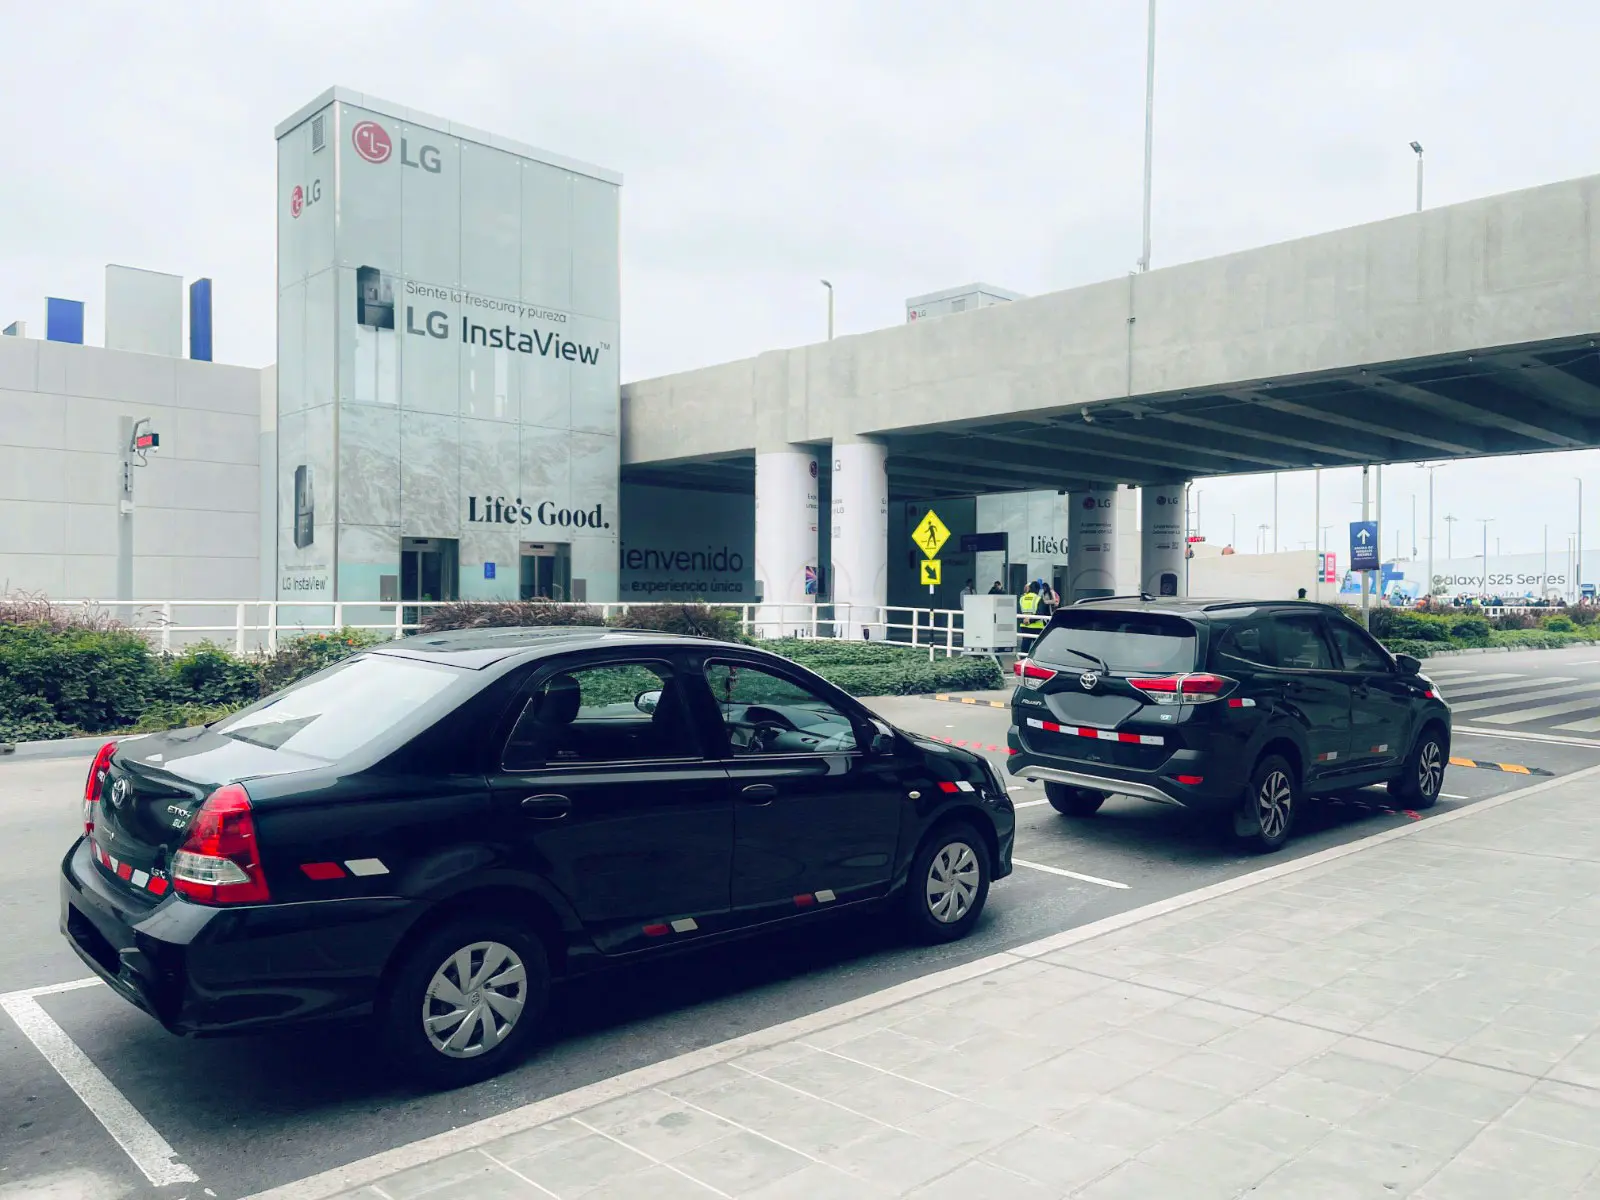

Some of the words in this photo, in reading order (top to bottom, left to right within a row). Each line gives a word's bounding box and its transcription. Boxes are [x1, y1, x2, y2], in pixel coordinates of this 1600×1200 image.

[400, 137, 442, 173] LG
[306, 179, 321, 207] LG
[406, 280, 448, 301] Siente
[450, 290, 463, 304] la
[465, 292, 516, 314] frescura
[517, 306, 526, 319] y
[528, 308, 567, 326] pureza
[406, 306, 449, 340] LG
[468, 496, 532, 526] Life's
[537, 500, 610, 529] Good.
[1098, 498, 1112, 508] LG
[1167, 497, 1179, 505] LG
[620, 541, 744, 572] ienvenido
[1030, 535, 1059, 554] Life's
[1488, 574, 1514, 585] S25
[1516, 573, 1565, 585] Series
